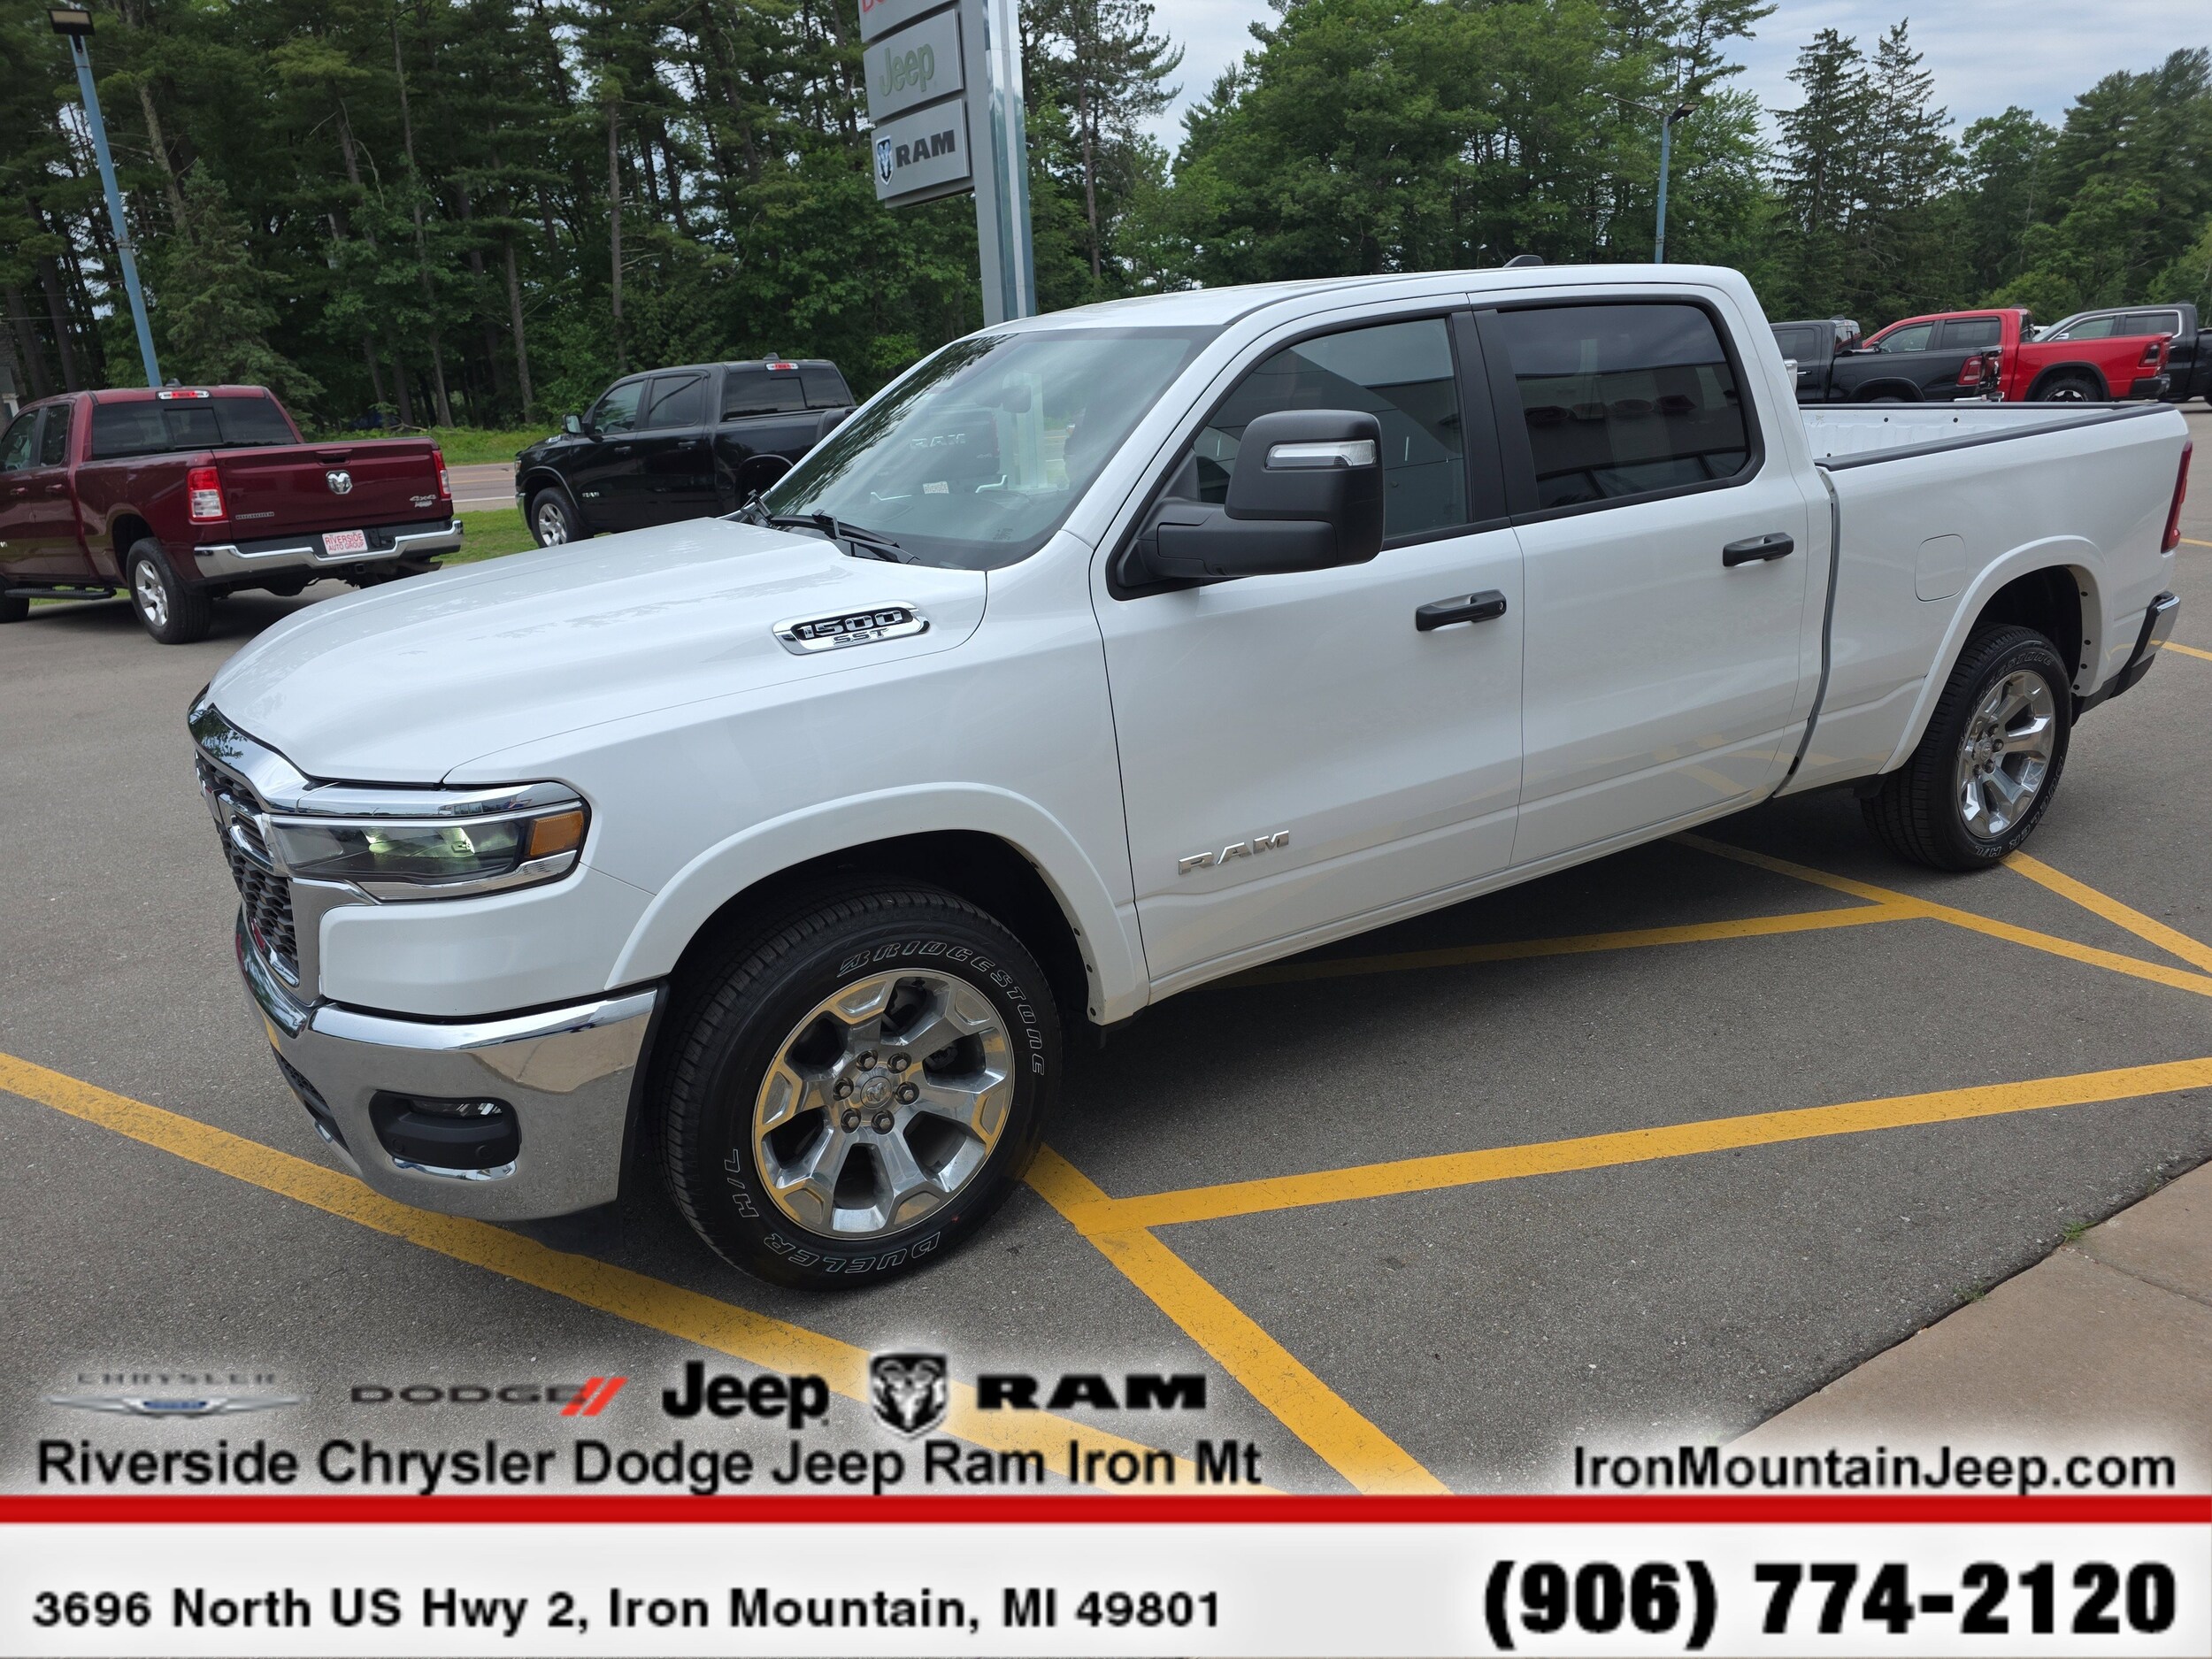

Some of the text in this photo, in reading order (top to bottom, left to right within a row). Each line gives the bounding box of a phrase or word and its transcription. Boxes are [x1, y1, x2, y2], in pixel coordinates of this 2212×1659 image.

[879, 43, 935, 97] Jeep
[895, 129, 956, 168] RAM
[910, 433, 965, 449] RAM
[325, 533, 364, 545] RIVERSIDE
[797, 610, 903, 639] 1500
[832, 627, 888, 645] SST
[1178, 830, 1289, 876] RAM
[837, 941, 1045, 1076] BRIDGESTONE
[764, 1231, 941, 1274] DUELER
